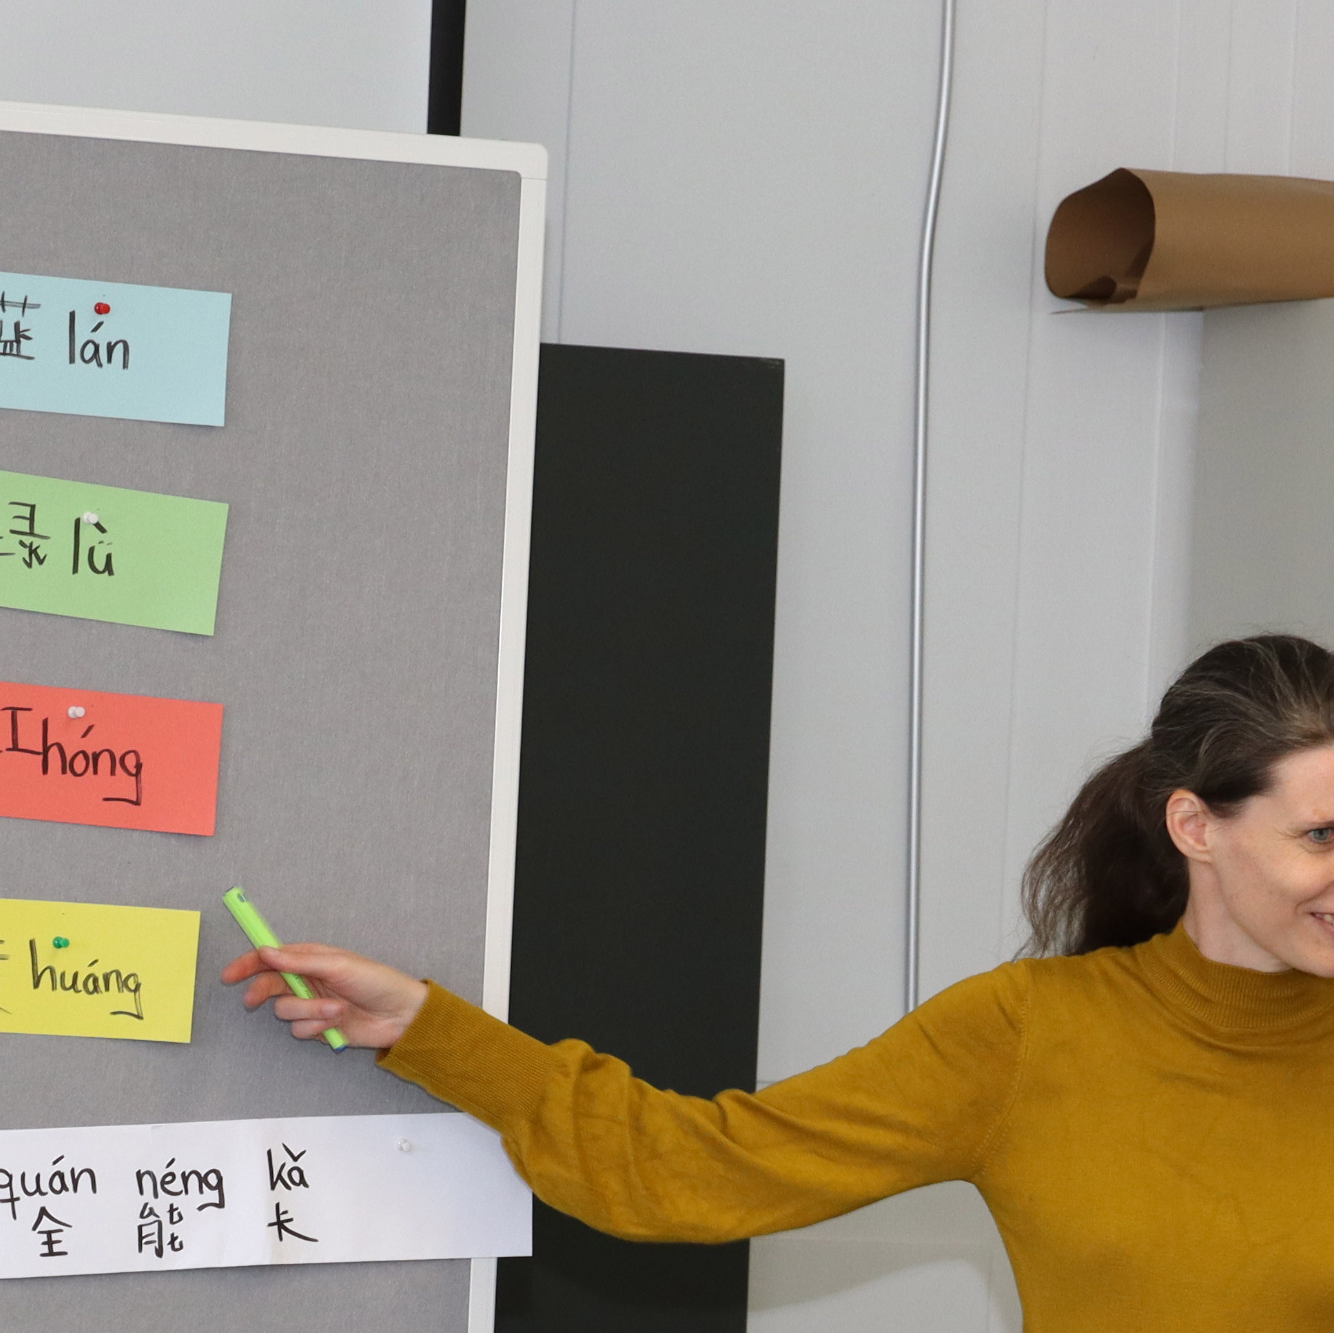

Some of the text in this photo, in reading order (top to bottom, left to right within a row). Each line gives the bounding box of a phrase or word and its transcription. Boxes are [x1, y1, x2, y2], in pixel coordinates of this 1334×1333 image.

[68, 310, 130, 370] lán
[40, 717, 143, 806] hóng
[28, 939, 144, 1021] huáng
[135, 1157, 226, 1212] néng
[266, 1142, 310, 1192] kǎ
[31, 1205, 73, 1258] 全
[267, 1201, 319, 1243] 卡
